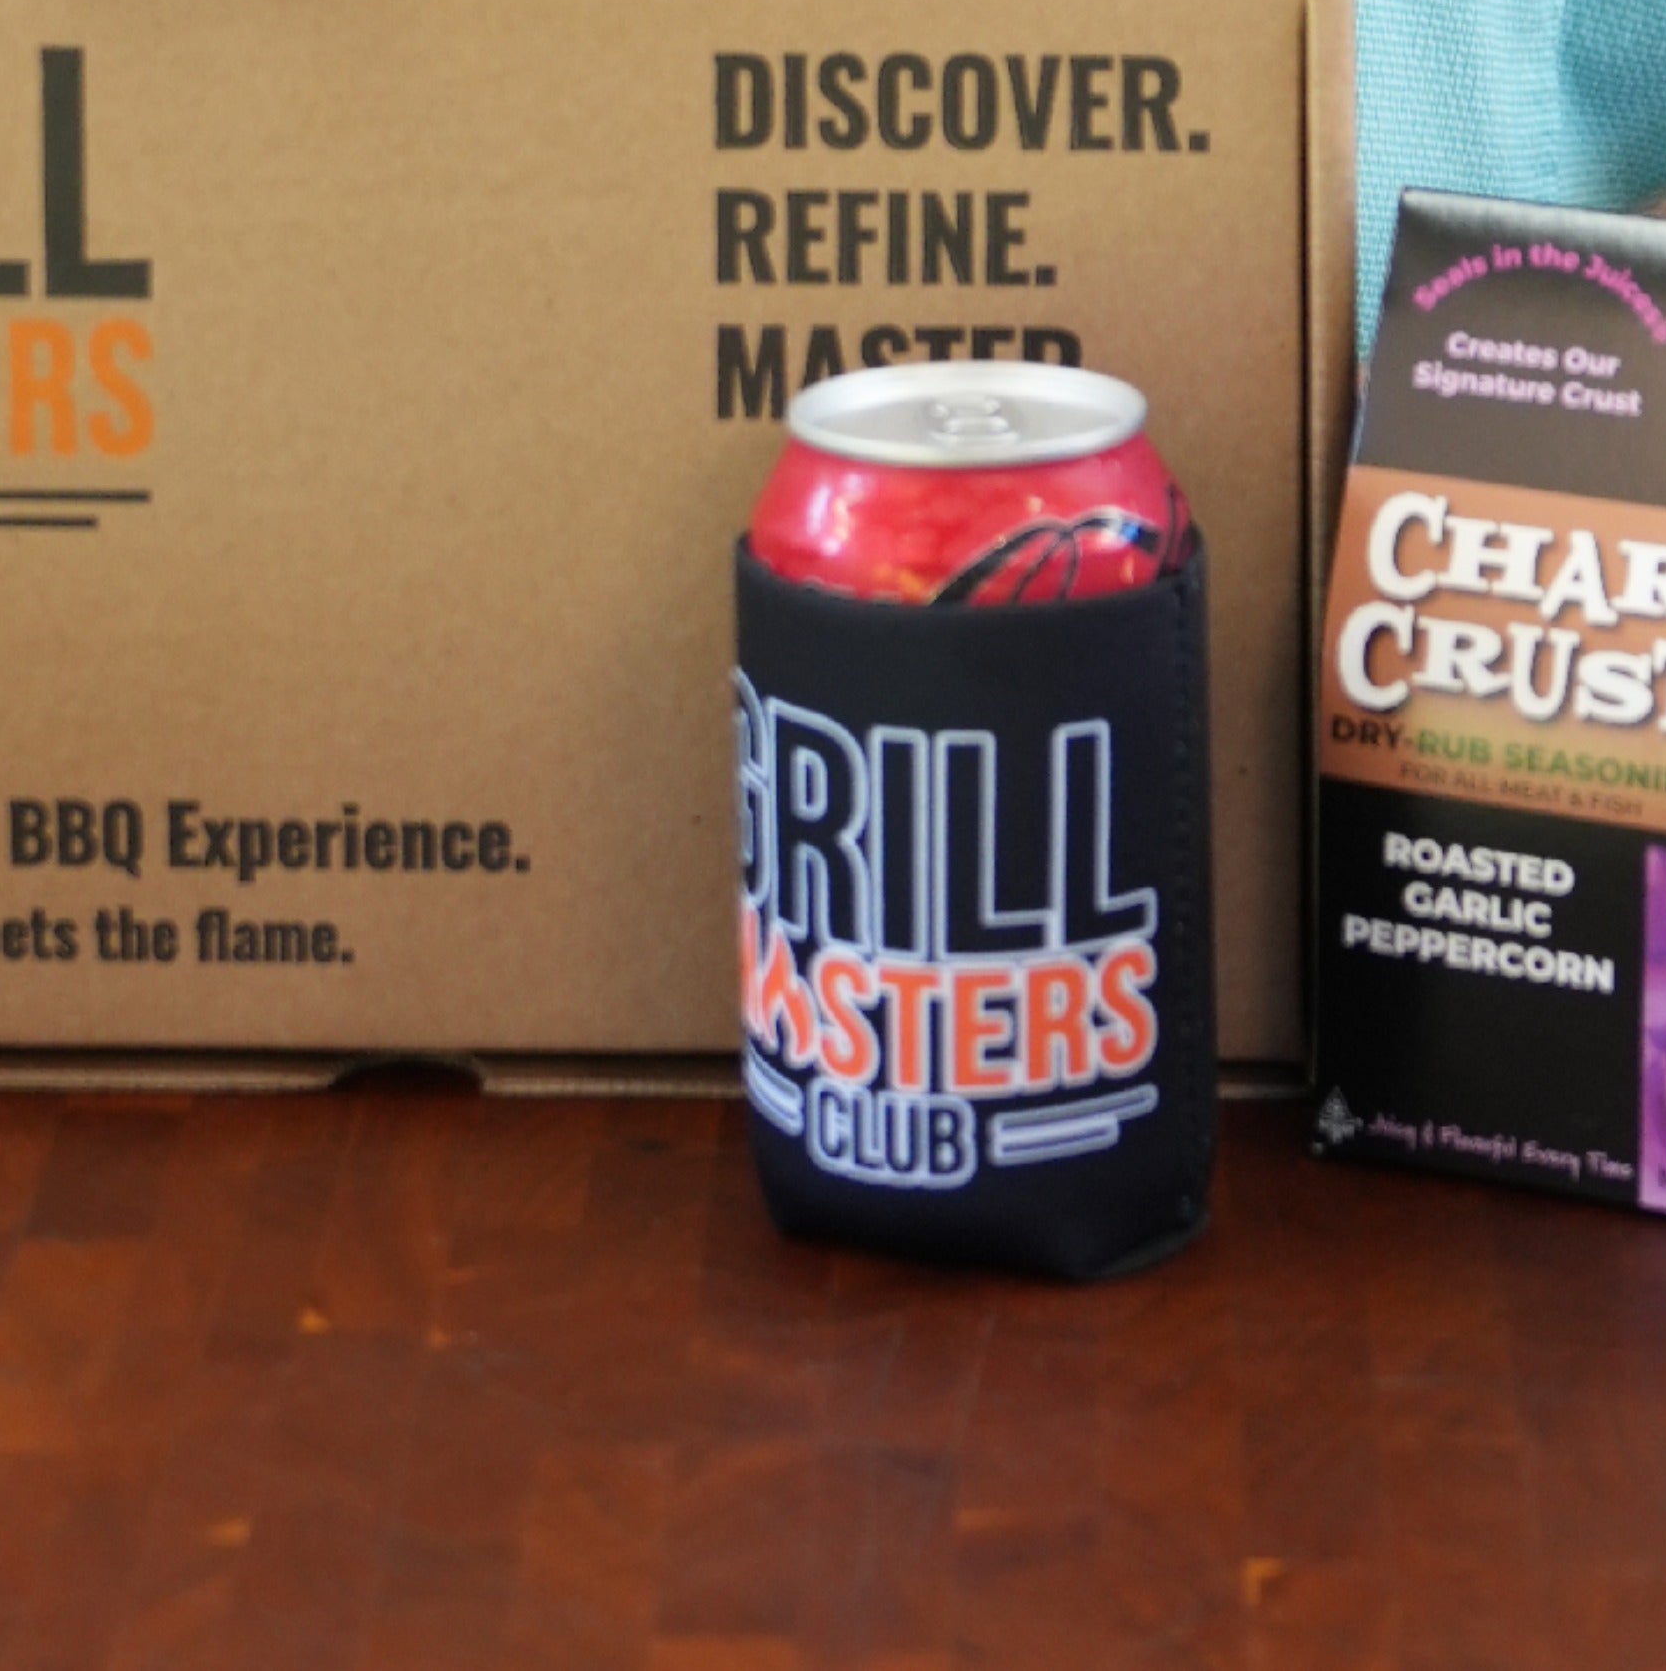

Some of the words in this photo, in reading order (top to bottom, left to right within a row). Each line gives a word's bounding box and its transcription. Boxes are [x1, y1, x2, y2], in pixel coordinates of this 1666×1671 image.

[713, 52, 1211, 153] DISCOVER.
[715, 190, 1058, 285] REFINE.
[1492, 243, 1522, 271] in
[1528, 242, 1581, 273] the
[1446, 331, 1559, 370] Creates
[1562, 346, 1622, 379] Our
[1413, 361, 1558, 405] Signature
[1560, 381, 1643, 418] Crust
[1331, 713, 1492, 765] DRY-RUB
[1500, 778, 1565, 801] MEAT
[1590, 794, 1644, 817] FISH
[7, 799, 145, 877] BBQ
[166, 800, 531, 881] Experience.
[1383, 831, 1575, 896] ROASTED
[95, 909, 179, 964] the
[196, 908, 356, 965] flame.
[1403, 881, 1553, 939] GARLIC
[1341, 914, 1615, 995] PEPPERCORN
[808, 1078, 976, 1186] CLUB
